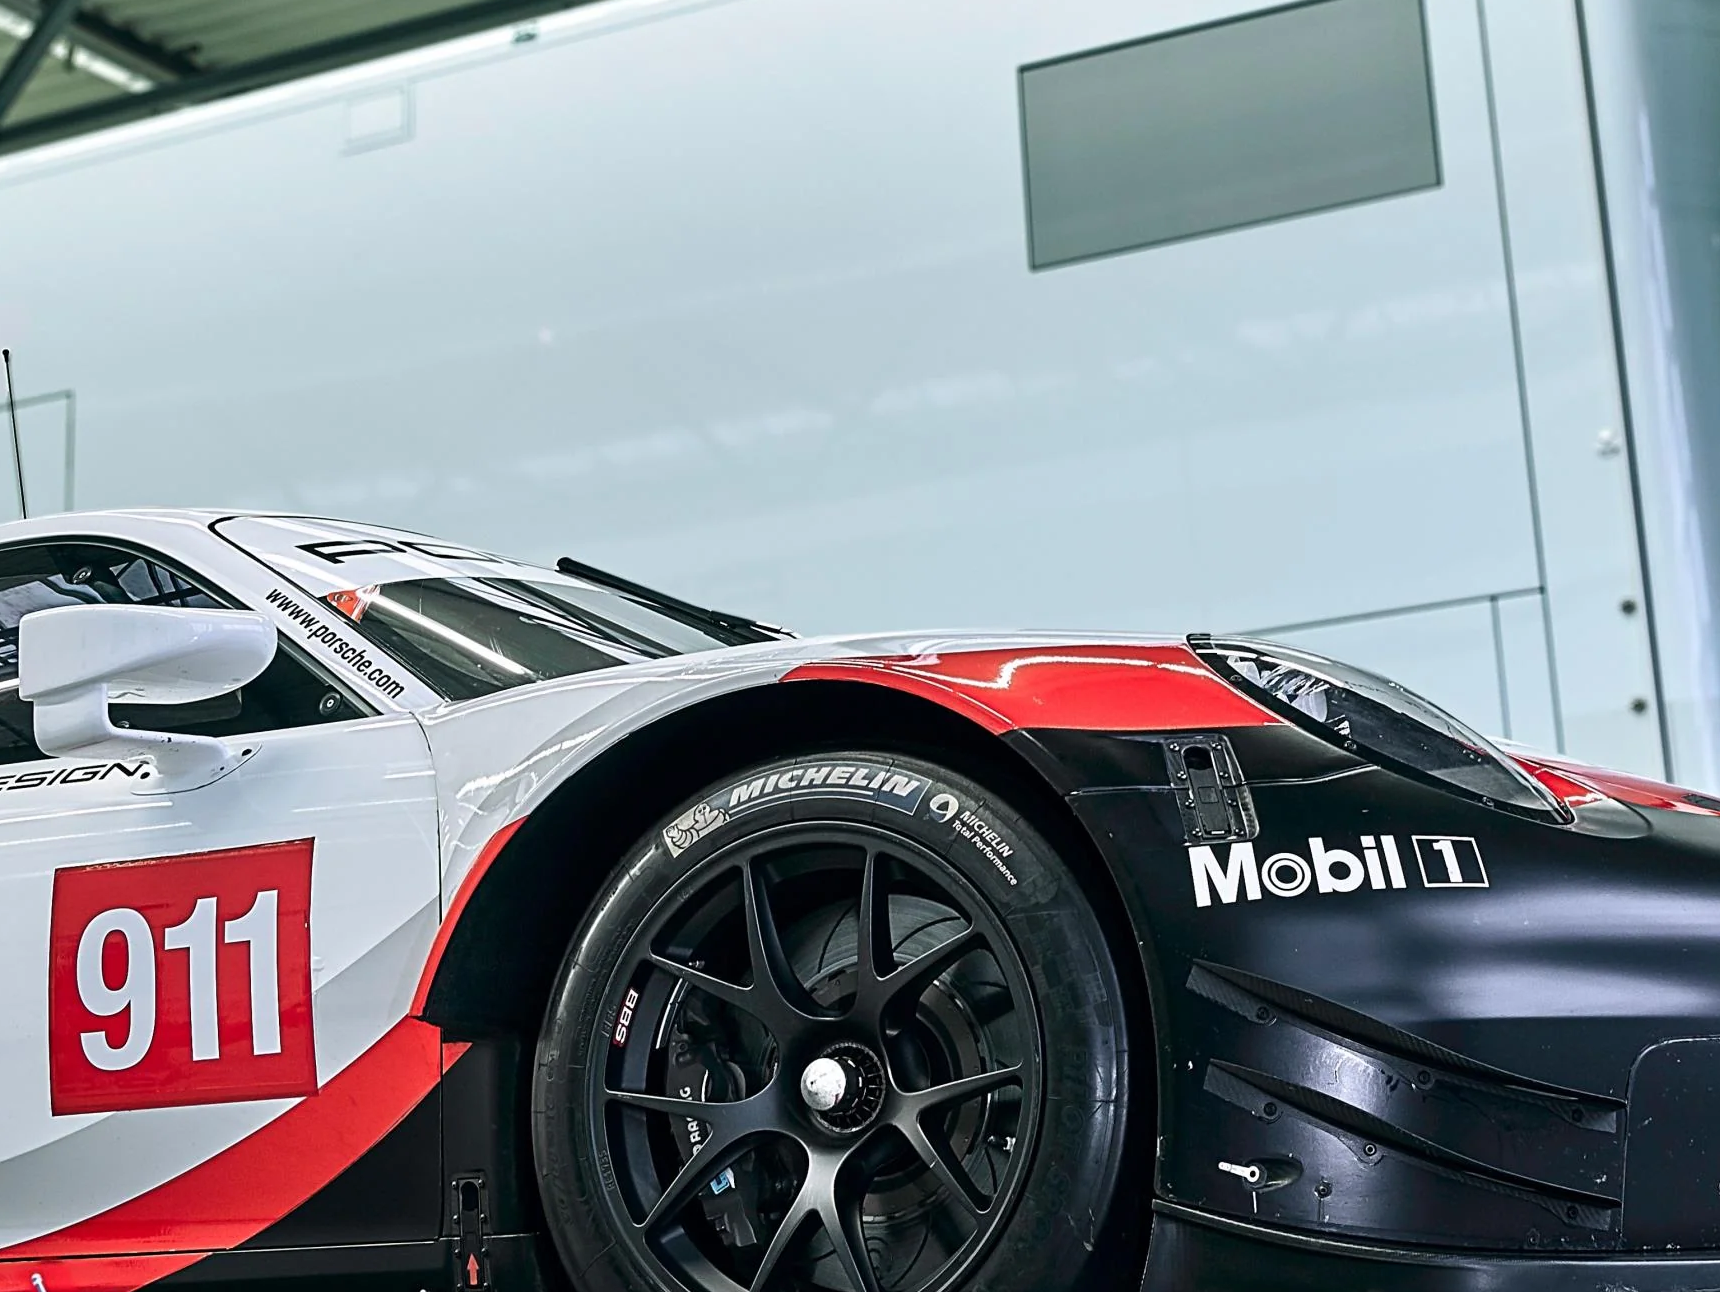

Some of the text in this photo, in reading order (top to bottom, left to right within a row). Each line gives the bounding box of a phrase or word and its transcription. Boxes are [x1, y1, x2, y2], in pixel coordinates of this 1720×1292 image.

[728, 766, 921, 808] MICHELIN
[951, 820, 1019, 887] Total Performance
[959, 810, 1014, 858] MICHELIN
[1186, 834, 1408, 908] Mobil
[76, 889, 284, 1072] 911
[614, 988, 639, 1044] BBS
